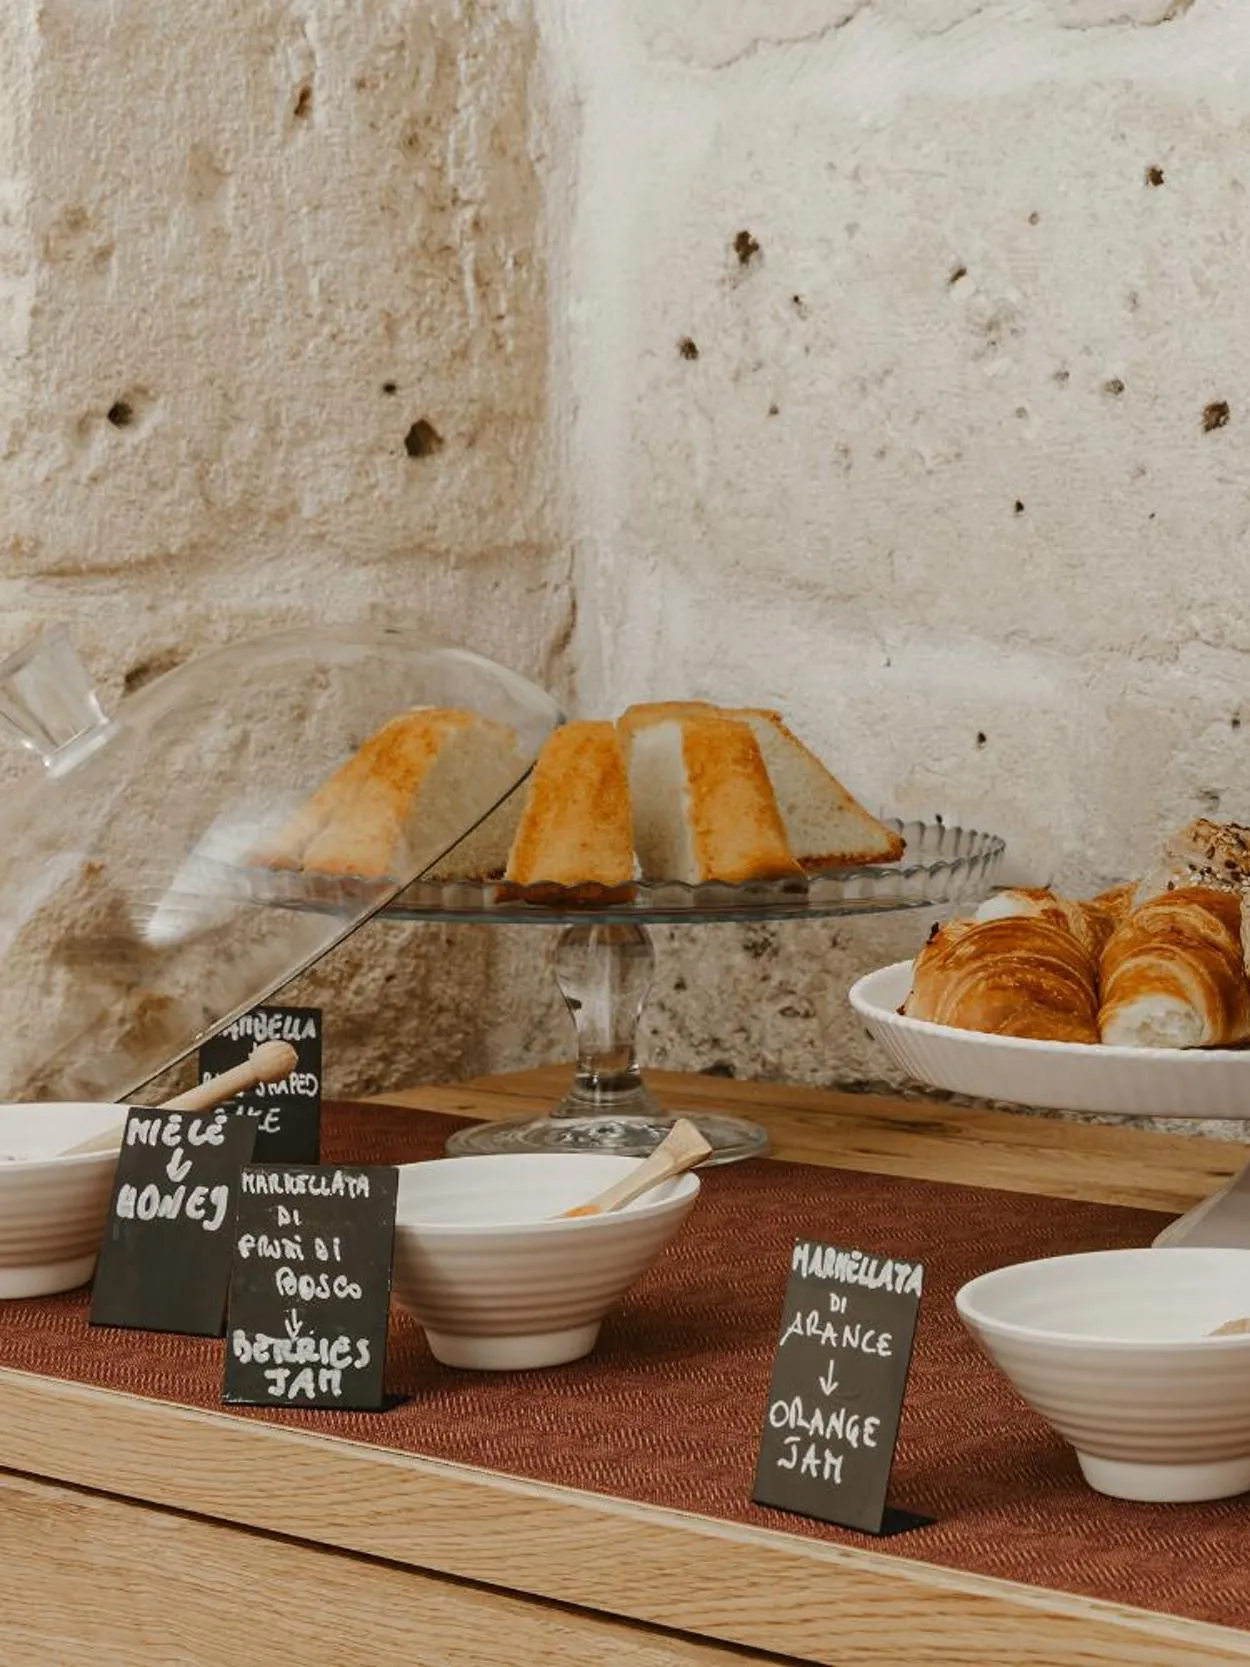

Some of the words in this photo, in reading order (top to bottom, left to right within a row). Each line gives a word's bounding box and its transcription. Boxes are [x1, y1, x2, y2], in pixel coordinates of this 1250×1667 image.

[241, 1170, 370, 1199] MARMELLATA
[116, 1183, 229, 1231] HONEY
[277, 1205, 302, 1228] DI
[275, 1266, 363, 1301] BOSCO
[792, 1243, 924, 1298] MARMELLATA
[829, 1292, 848, 1314] DI
[233, 1328, 371, 1369] BERRIES
[779, 1309, 893, 1357] ARANCE
[264, 1366, 342, 1400] JAM
[769, 1396, 881, 1449] ORANGE
[777, 1436, 844, 1485] JAM
